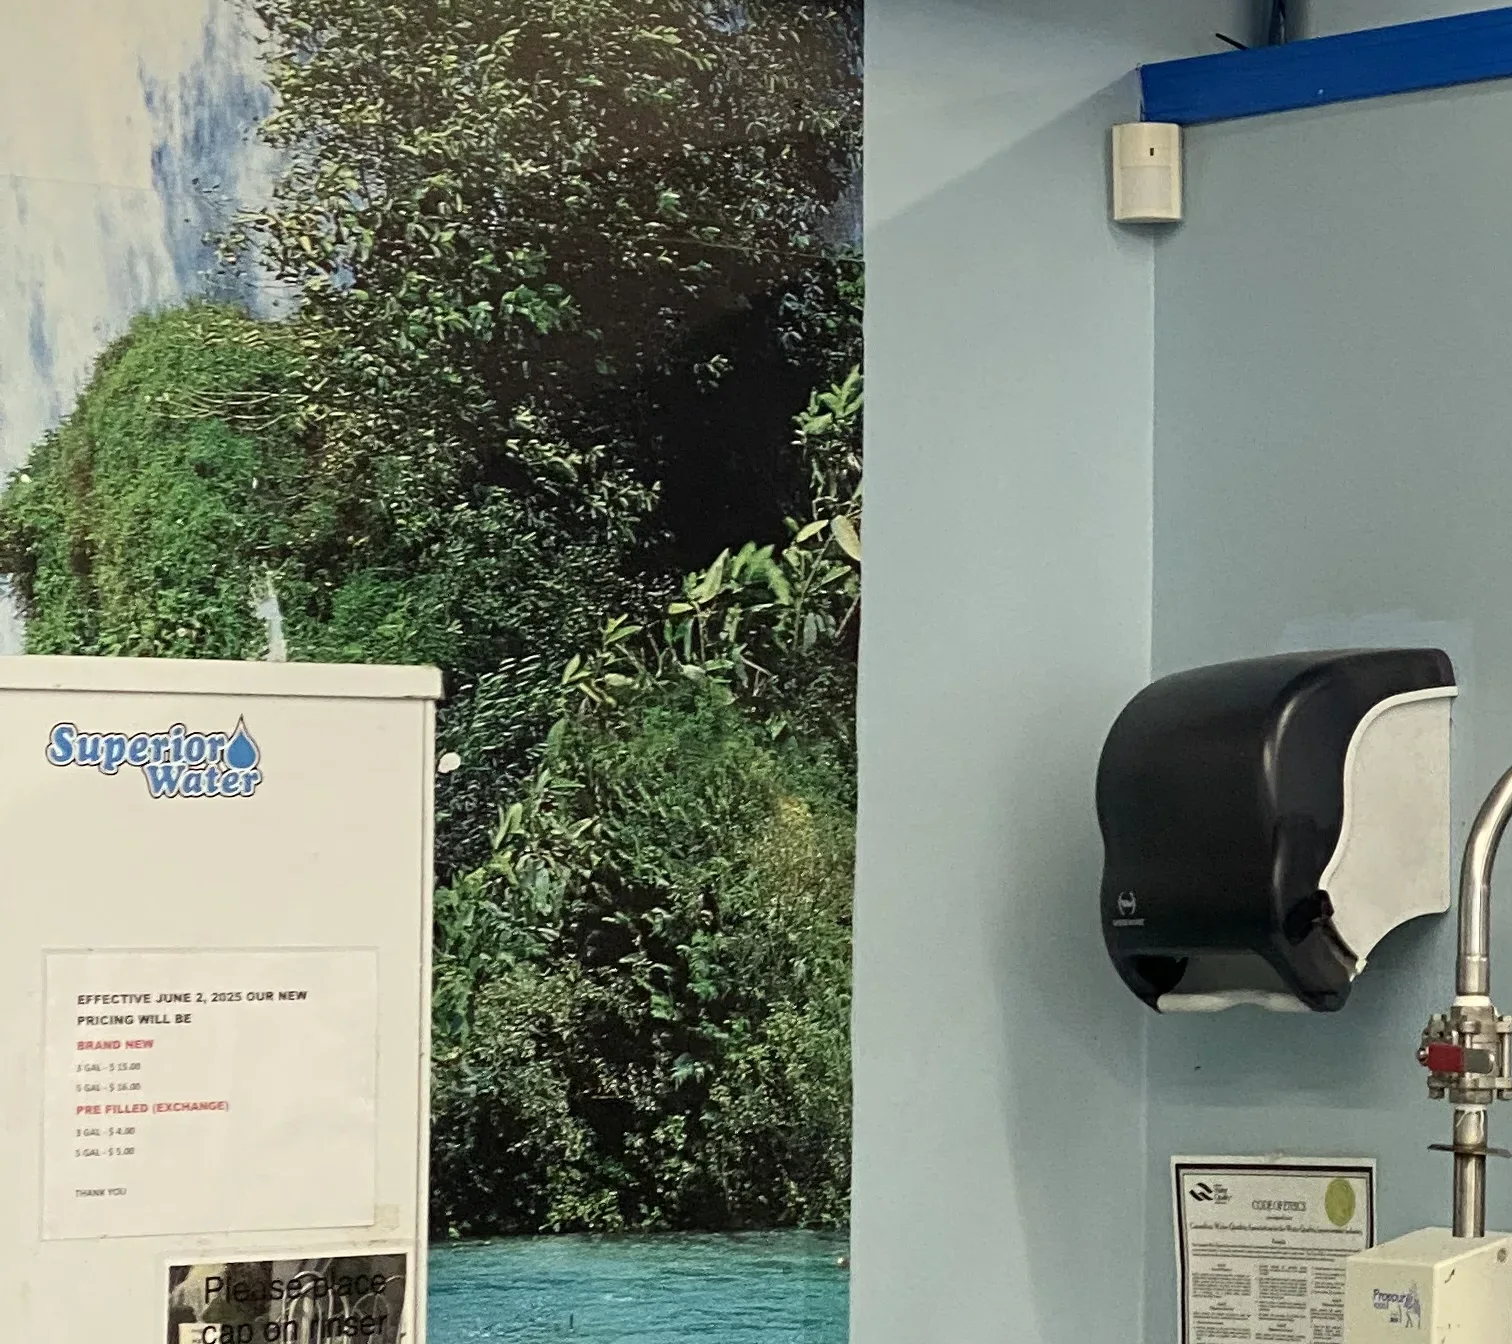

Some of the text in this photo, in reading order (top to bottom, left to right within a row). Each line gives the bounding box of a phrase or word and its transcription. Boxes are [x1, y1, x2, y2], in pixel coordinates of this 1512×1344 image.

[48, 724, 226, 773] Superior
[145, 764, 260, 796] Water
[77, 994, 151, 1004] EFFECTIVE
[156, 993, 191, 1003] JUNE
[210, 992, 241, 1002] 2025
[246, 991, 274, 1002] OUR
[278, 990, 308, 1001] NEW
[77, 1013, 192, 1025] PRICING WILL BE
[77, 1039, 154, 1051] BRAND NEW
[76, 1101, 229, 1115] PRE FILLED (EXCHANGE)
[204, 1268, 387, 1306] Please place
[263, 1319, 298, 1343] on
